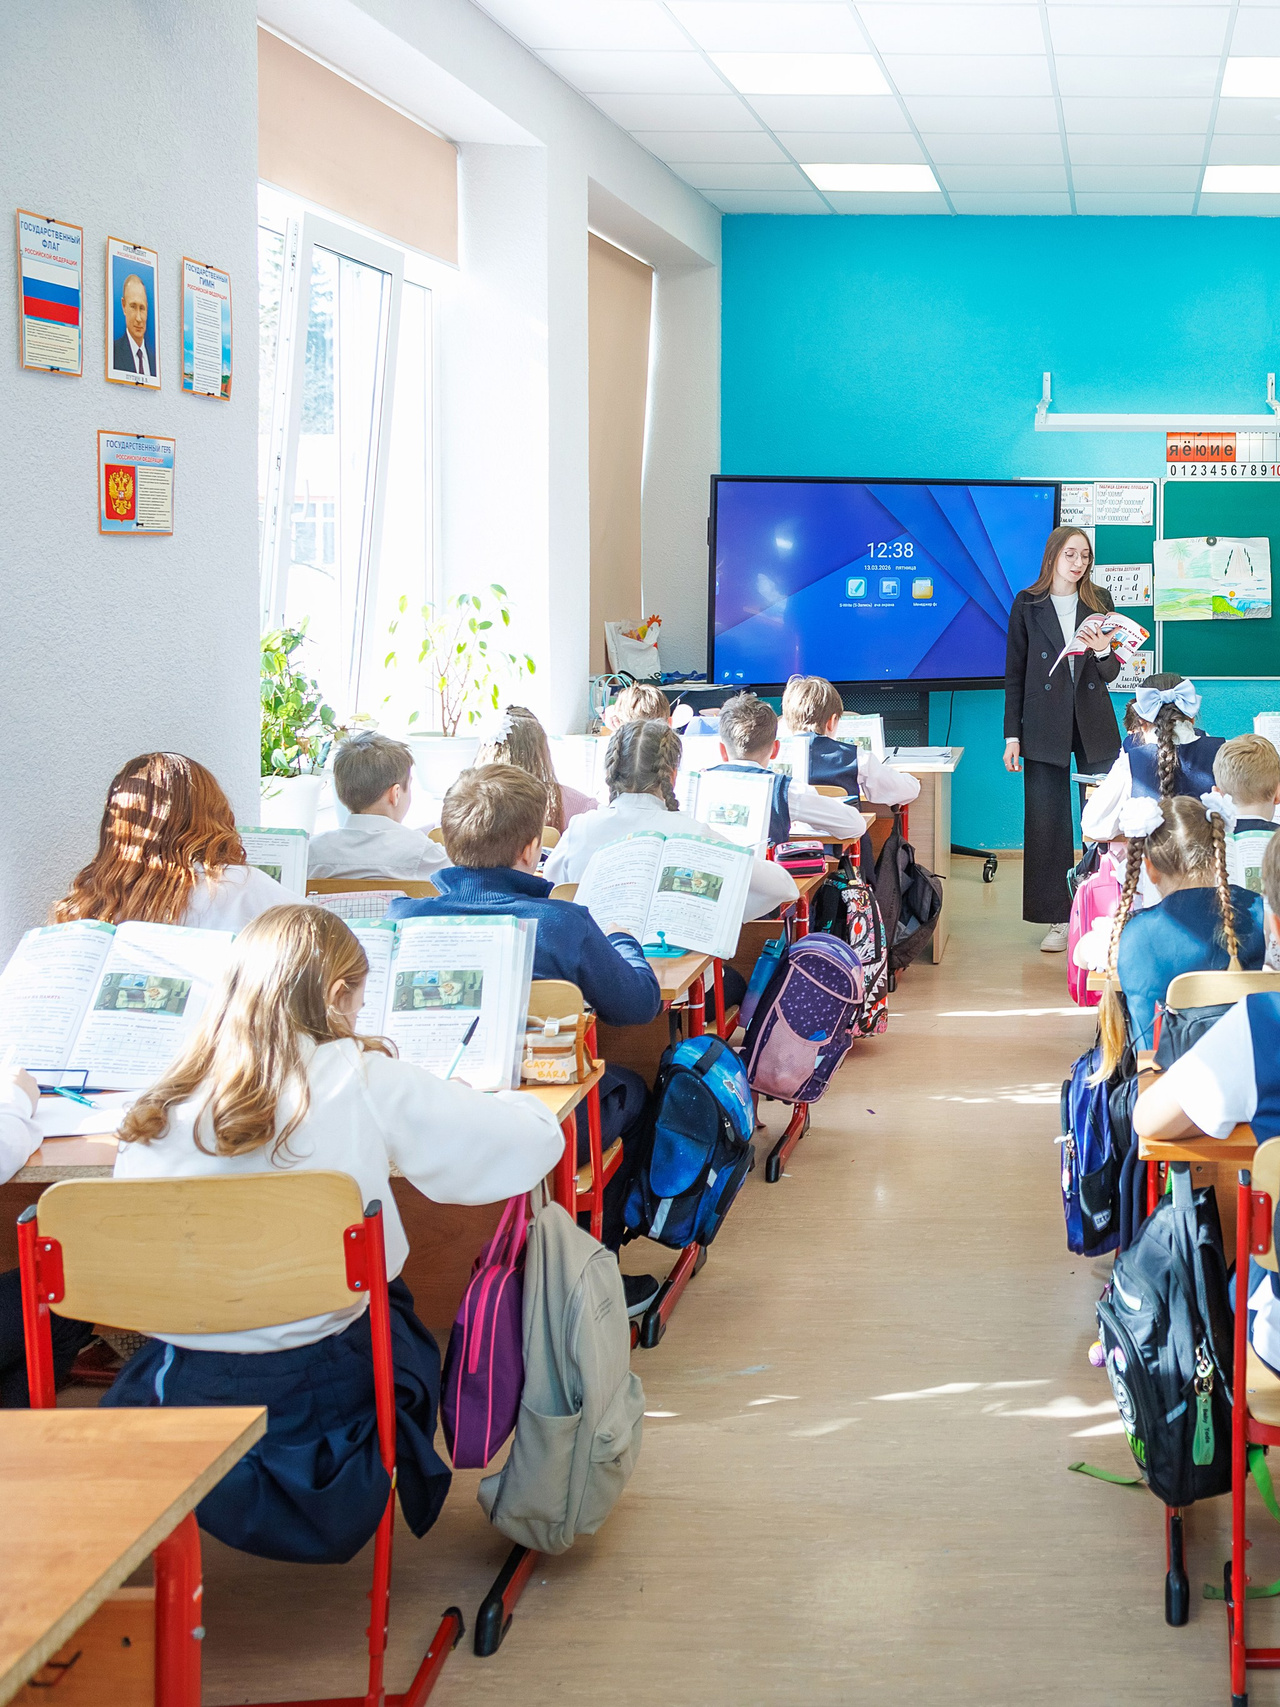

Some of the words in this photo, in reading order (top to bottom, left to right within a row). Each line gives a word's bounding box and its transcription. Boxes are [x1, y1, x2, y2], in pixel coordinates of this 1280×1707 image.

[20, 220, 80, 245] ГОСУДАРСТВЕННЫЙ
[41, 238, 60, 251] ФЛАГ
[24, 247, 52, 260] РОССИЙСКОЙ
[52, 255, 77, 266] ФЕДЕРАЦИИ
[185, 262, 228, 285] ГОСУДАРСТВЕННЫЙ
[199, 276, 215, 290] ГИМН
[187, 283, 209, 296] РОССИЙСКОЙ
[209, 290, 228, 301] ФЕДЕРАЦИИ
[106, 439, 160, 453] ГОСУДАРСТВЕННЫЙ
[161, 445, 171, 454] ГЕРБ
[1169, 445, 1178, 456] я
[1182, 440, 1192, 456] ё
[1196, 444, 1207, 456] ю
[1210, 444, 1220, 456] и
[1224, 444, 1233, 456] е
[115, 453, 142, 462] РОССИЙСКОЙ
[142, 455, 164, 464] ФЕДЕРАЦИИ
[1170, 464, 1177, 477] 0
[1181, 464, 1186, 477] 1
[1190, 464, 1197, 477] 2
[1200, 464, 1207, 477] 3
[1210, 464, 1217, 477] 4
[1220, 464, 1227, 477] 5
[1230, 464, 1237, 477] 6
[1240, 464, 1247, 477] 7
[1250, 464, 1257, 477] 8
[1260, 464, 1267, 477] 9
[867, 542, 914, 558] 12:38
[525, 1060, 555, 1069] CAPY
[537, 1070, 568, 1079] BARA
[1202, 1427, 1212, 1444] Yoda
